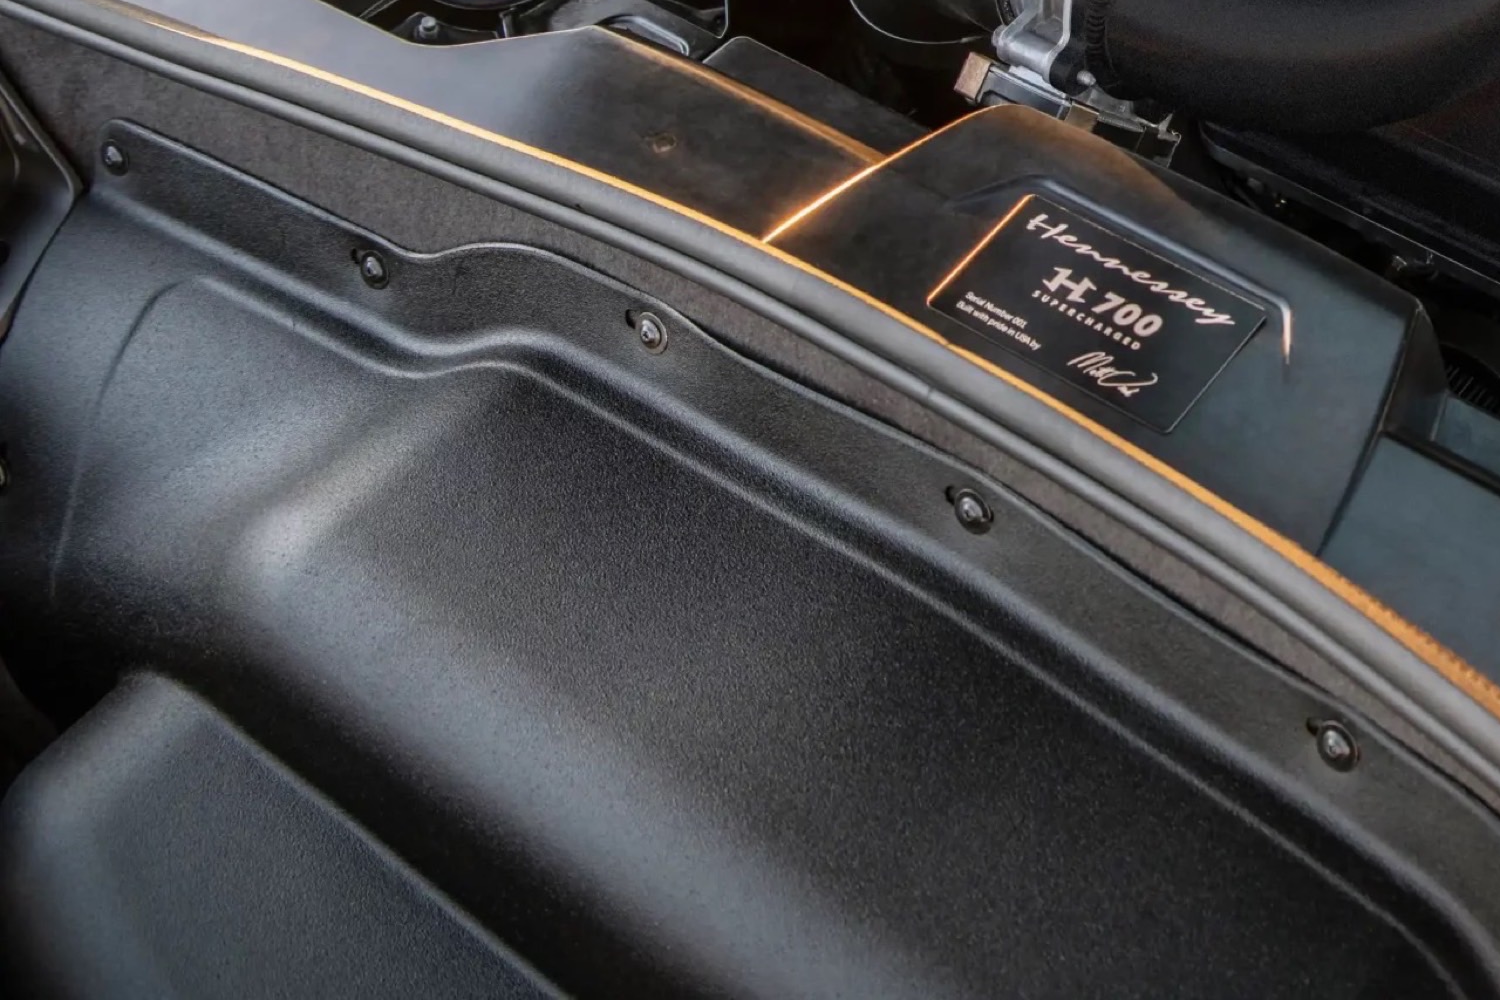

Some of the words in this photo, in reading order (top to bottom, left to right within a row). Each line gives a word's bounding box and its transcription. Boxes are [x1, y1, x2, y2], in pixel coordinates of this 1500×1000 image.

[1026, 213, 1236, 325] Hennessey
[965, 291, 987, 306] Serial
[984, 302, 1014, 321] Number
[1031, 289, 1141, 351] SUPERCHARGED
[1091, 291, 1164, 338] 700
[972, 310, 990, 323] with
[1014, 331, 1031, 345] USA
[1029, 338, 1042, 351] by
